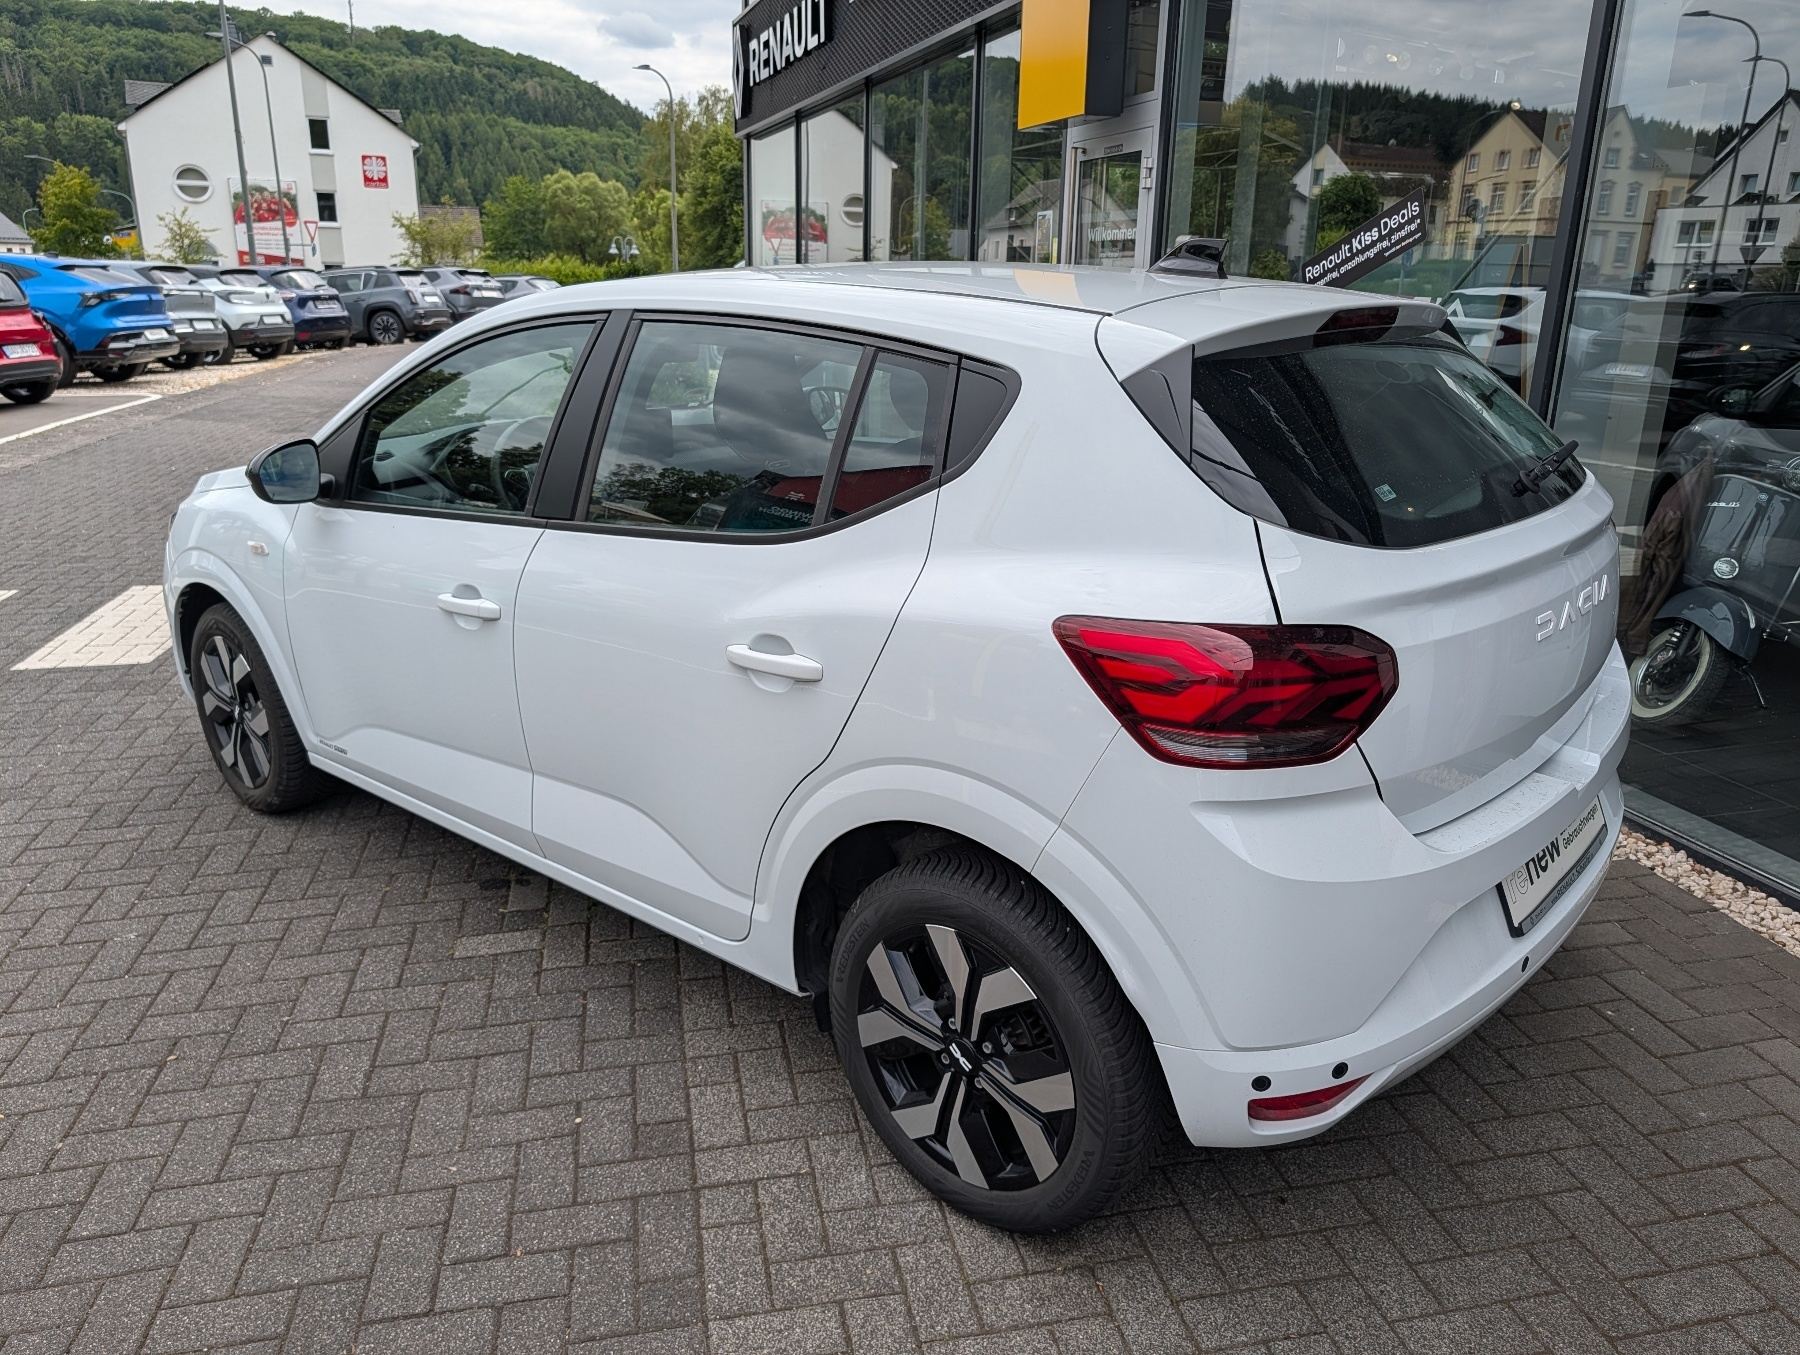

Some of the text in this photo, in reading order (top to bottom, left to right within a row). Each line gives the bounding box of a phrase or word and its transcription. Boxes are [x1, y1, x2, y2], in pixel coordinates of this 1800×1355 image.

[749, 0, 825, 87] RENAULT
[1305, 201, 1420, 282] Renault Kiss Deals
[1340, 239, 1391, 274] anzahlungsfrei,
[1536, 574, 1610, 641] DACIA
[1505, 837, 1560, 905] renew
